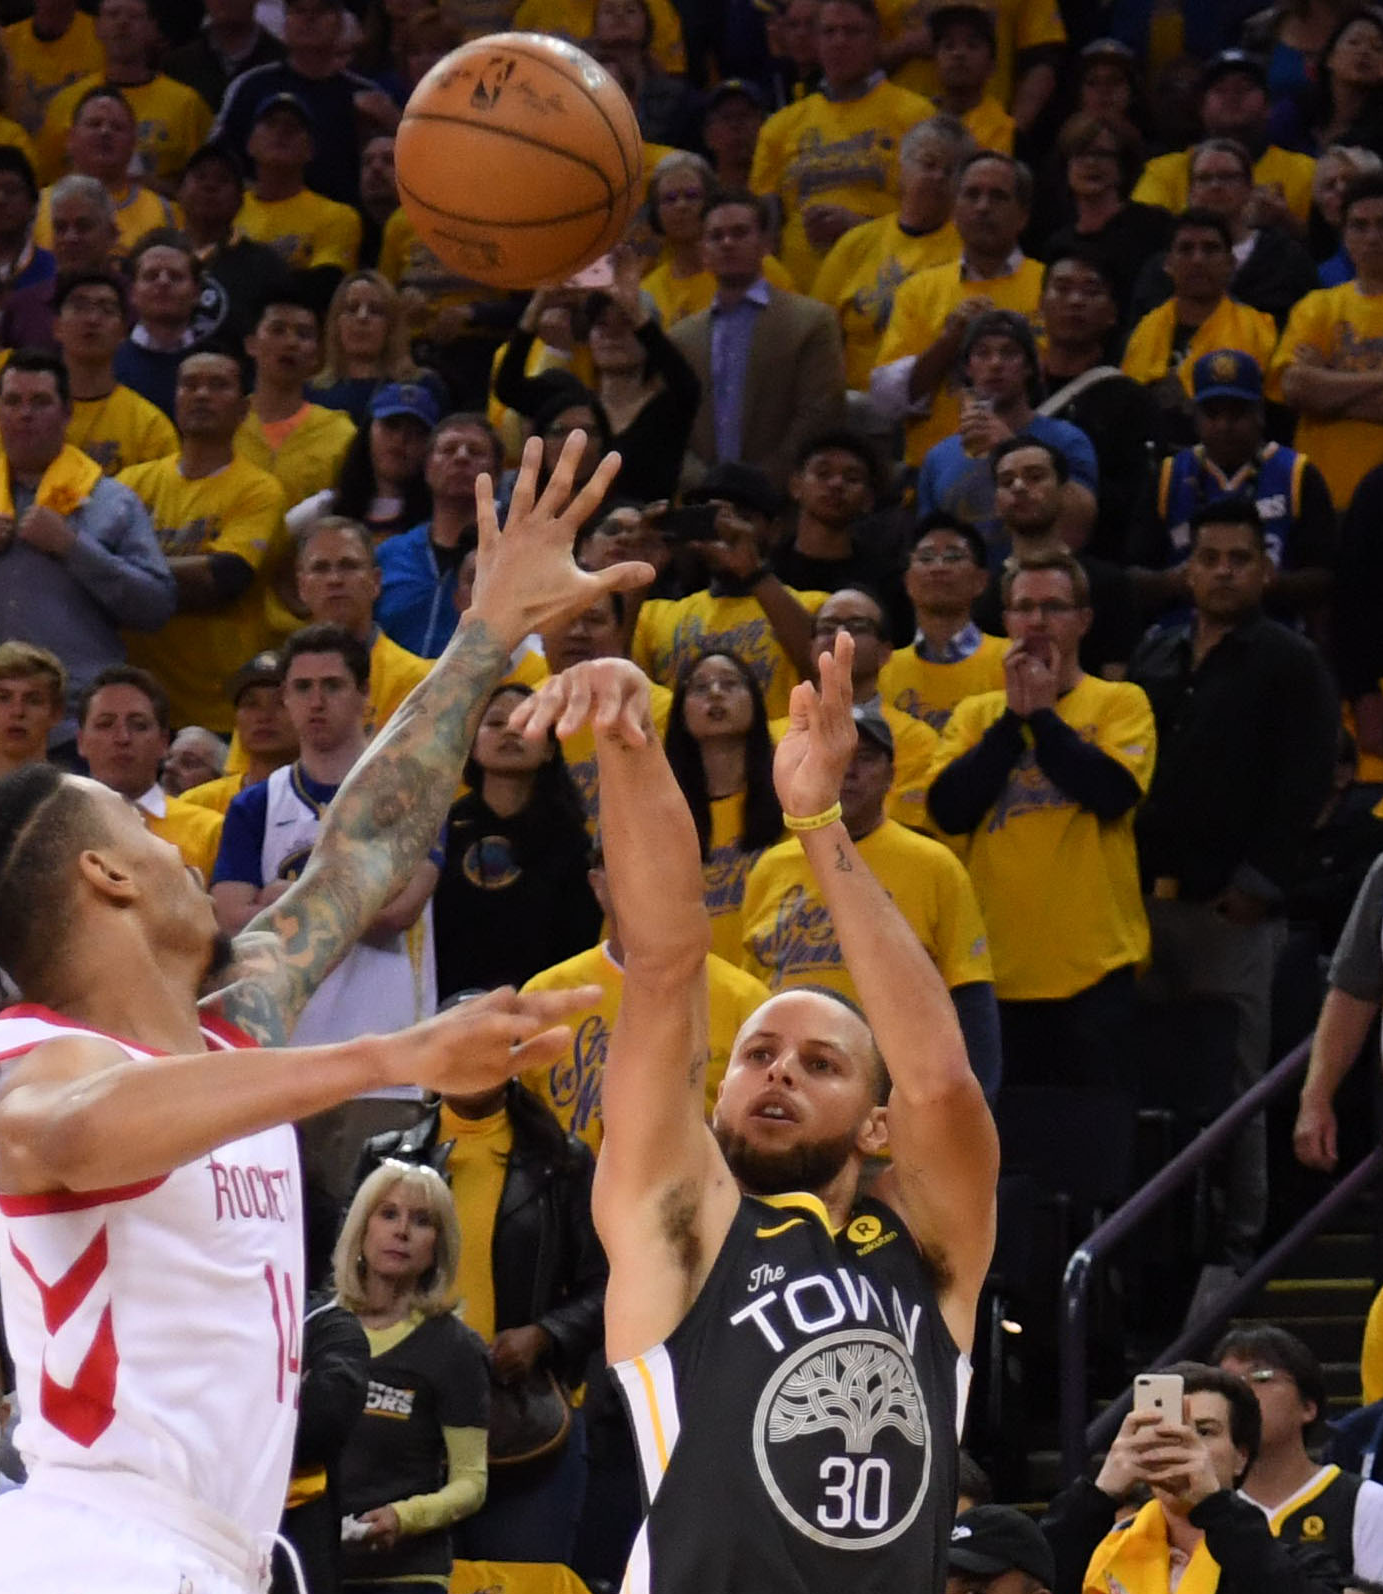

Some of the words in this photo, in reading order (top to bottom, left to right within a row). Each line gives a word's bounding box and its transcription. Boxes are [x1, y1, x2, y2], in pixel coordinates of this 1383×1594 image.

[729, 1267, 922, 1357] TOWN
[747, 1263, 786, 1293] The
[816, 1456, 891, 1529] 30
